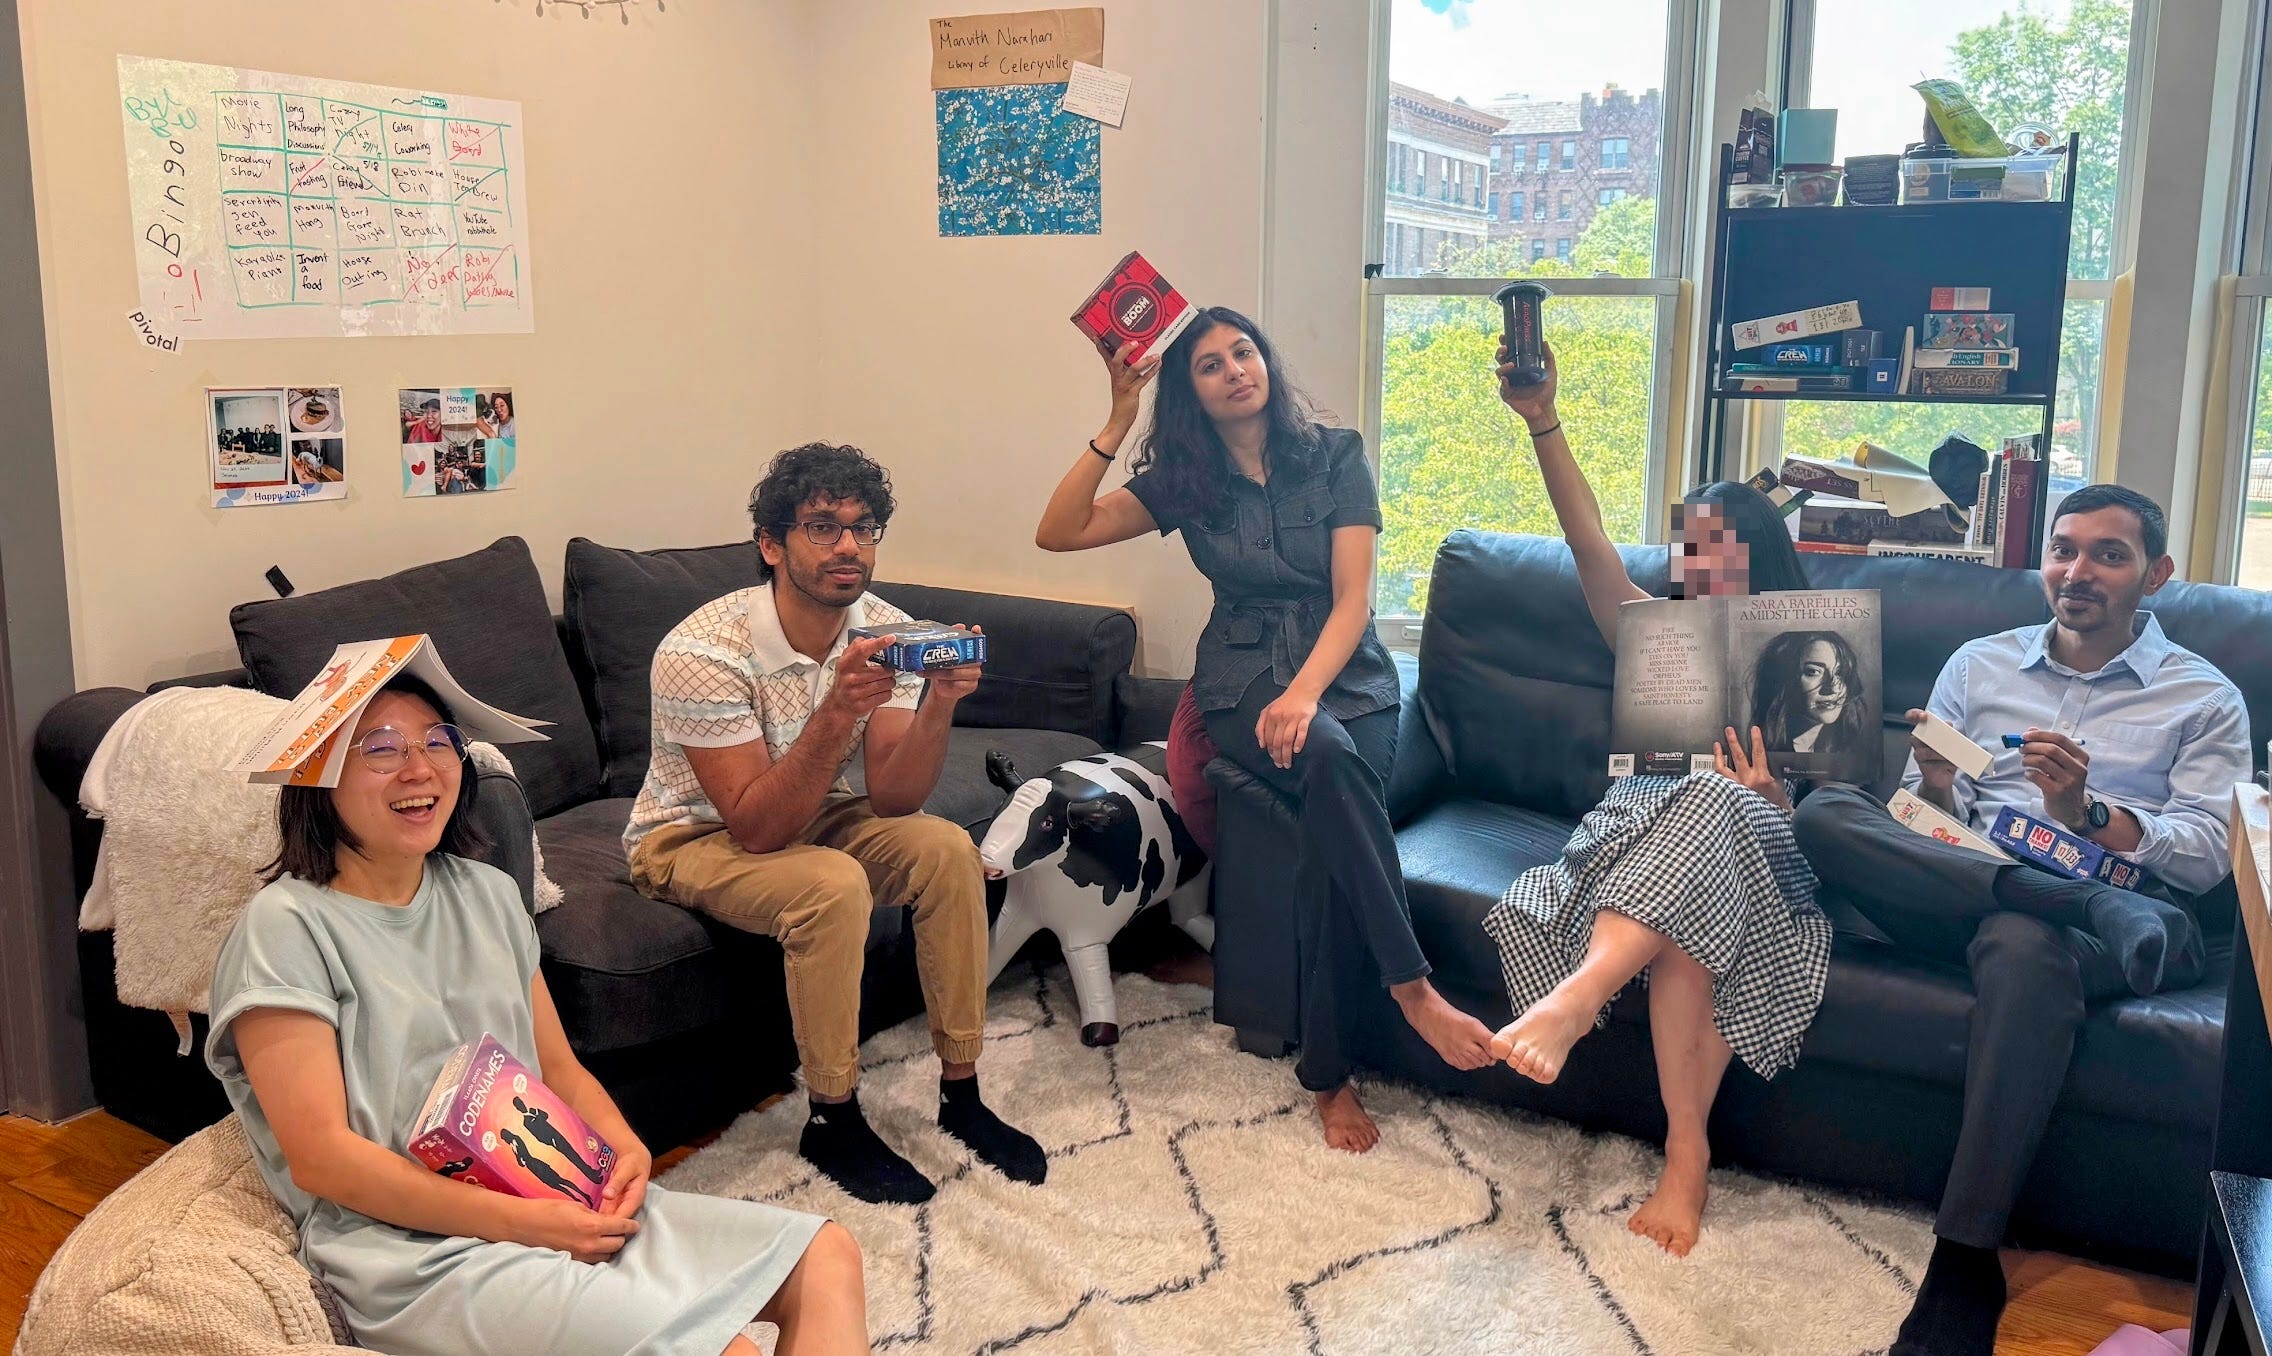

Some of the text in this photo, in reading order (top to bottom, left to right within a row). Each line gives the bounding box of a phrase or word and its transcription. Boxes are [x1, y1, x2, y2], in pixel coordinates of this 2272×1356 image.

[937, 20, 952, 28] The
[940, 30, 990, 49] Manvith
[978, 54, 990, 68] of
[1000, 54, 1069, 78] Celeryville
[221, 96, 262, 110] Movie
[285, 102, 304, 122] Long
[224, 116, 272, 138] Nights
[288, 120, 326, 136] Philosophy
[220, 149, 272, 168] broadway
[231, 166, 262, 178] show
[146, 140, 185, 258] Bingo
[394, 208, 423, 219] Rat
[236, 217, 267, 235] feed
[400, 222, 446, 238] Brunch
[253, 229, 277, 240] you
[296, 252, 330, 264] Invent
[300, 265, 308, 273] a
[302, 275, 322, 290] food
[1122, 296, 1150, 326] BOOM
[128, 311, 178, 352] pivotal
[1960, 352, 1982, 360] English
[1940, 373, 1996, 386] AVALON
[446, 396, 469, 404] Happy
[254, 488, 309, 503] Happy 2024!
[1752, 597, 1857, 610] SARA BAREILLES
[1740, 608, 1872, 620] AMIDST THE CHAOS
[2015, 823, 2020, 833] 5
[2032, 827, 2053, 844] NO
[2066, 852, 2078, 864] 33
[2114, 864, 2128, 879] NO
[460, 1050, 506, 1136] CODENAMES
